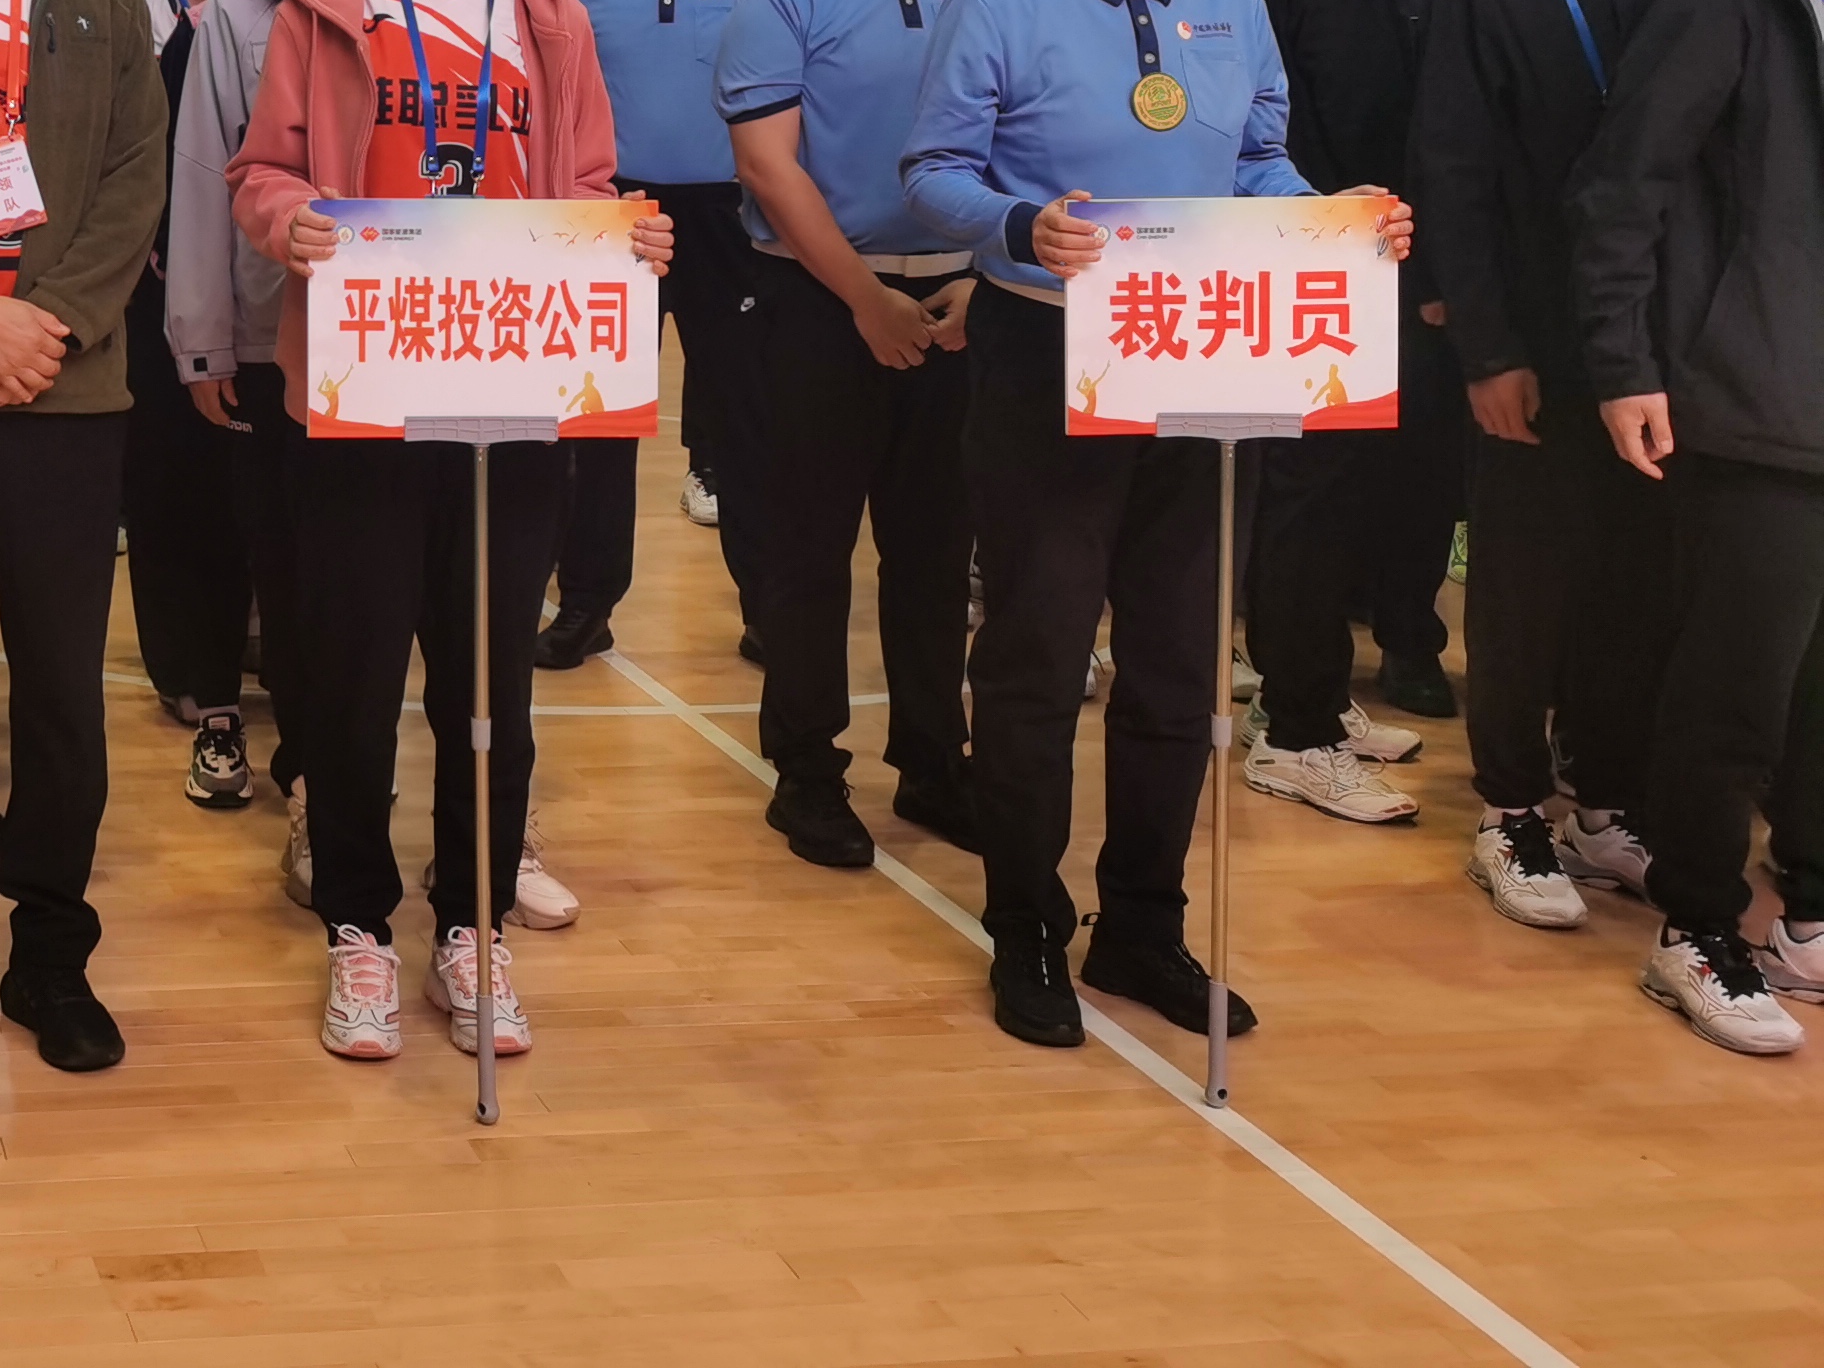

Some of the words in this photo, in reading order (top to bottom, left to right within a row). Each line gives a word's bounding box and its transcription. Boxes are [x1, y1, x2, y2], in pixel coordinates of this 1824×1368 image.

[339, 276, 628, 363] 平煤投资公司
[1108, 270, 1358, 360] 裁判员
